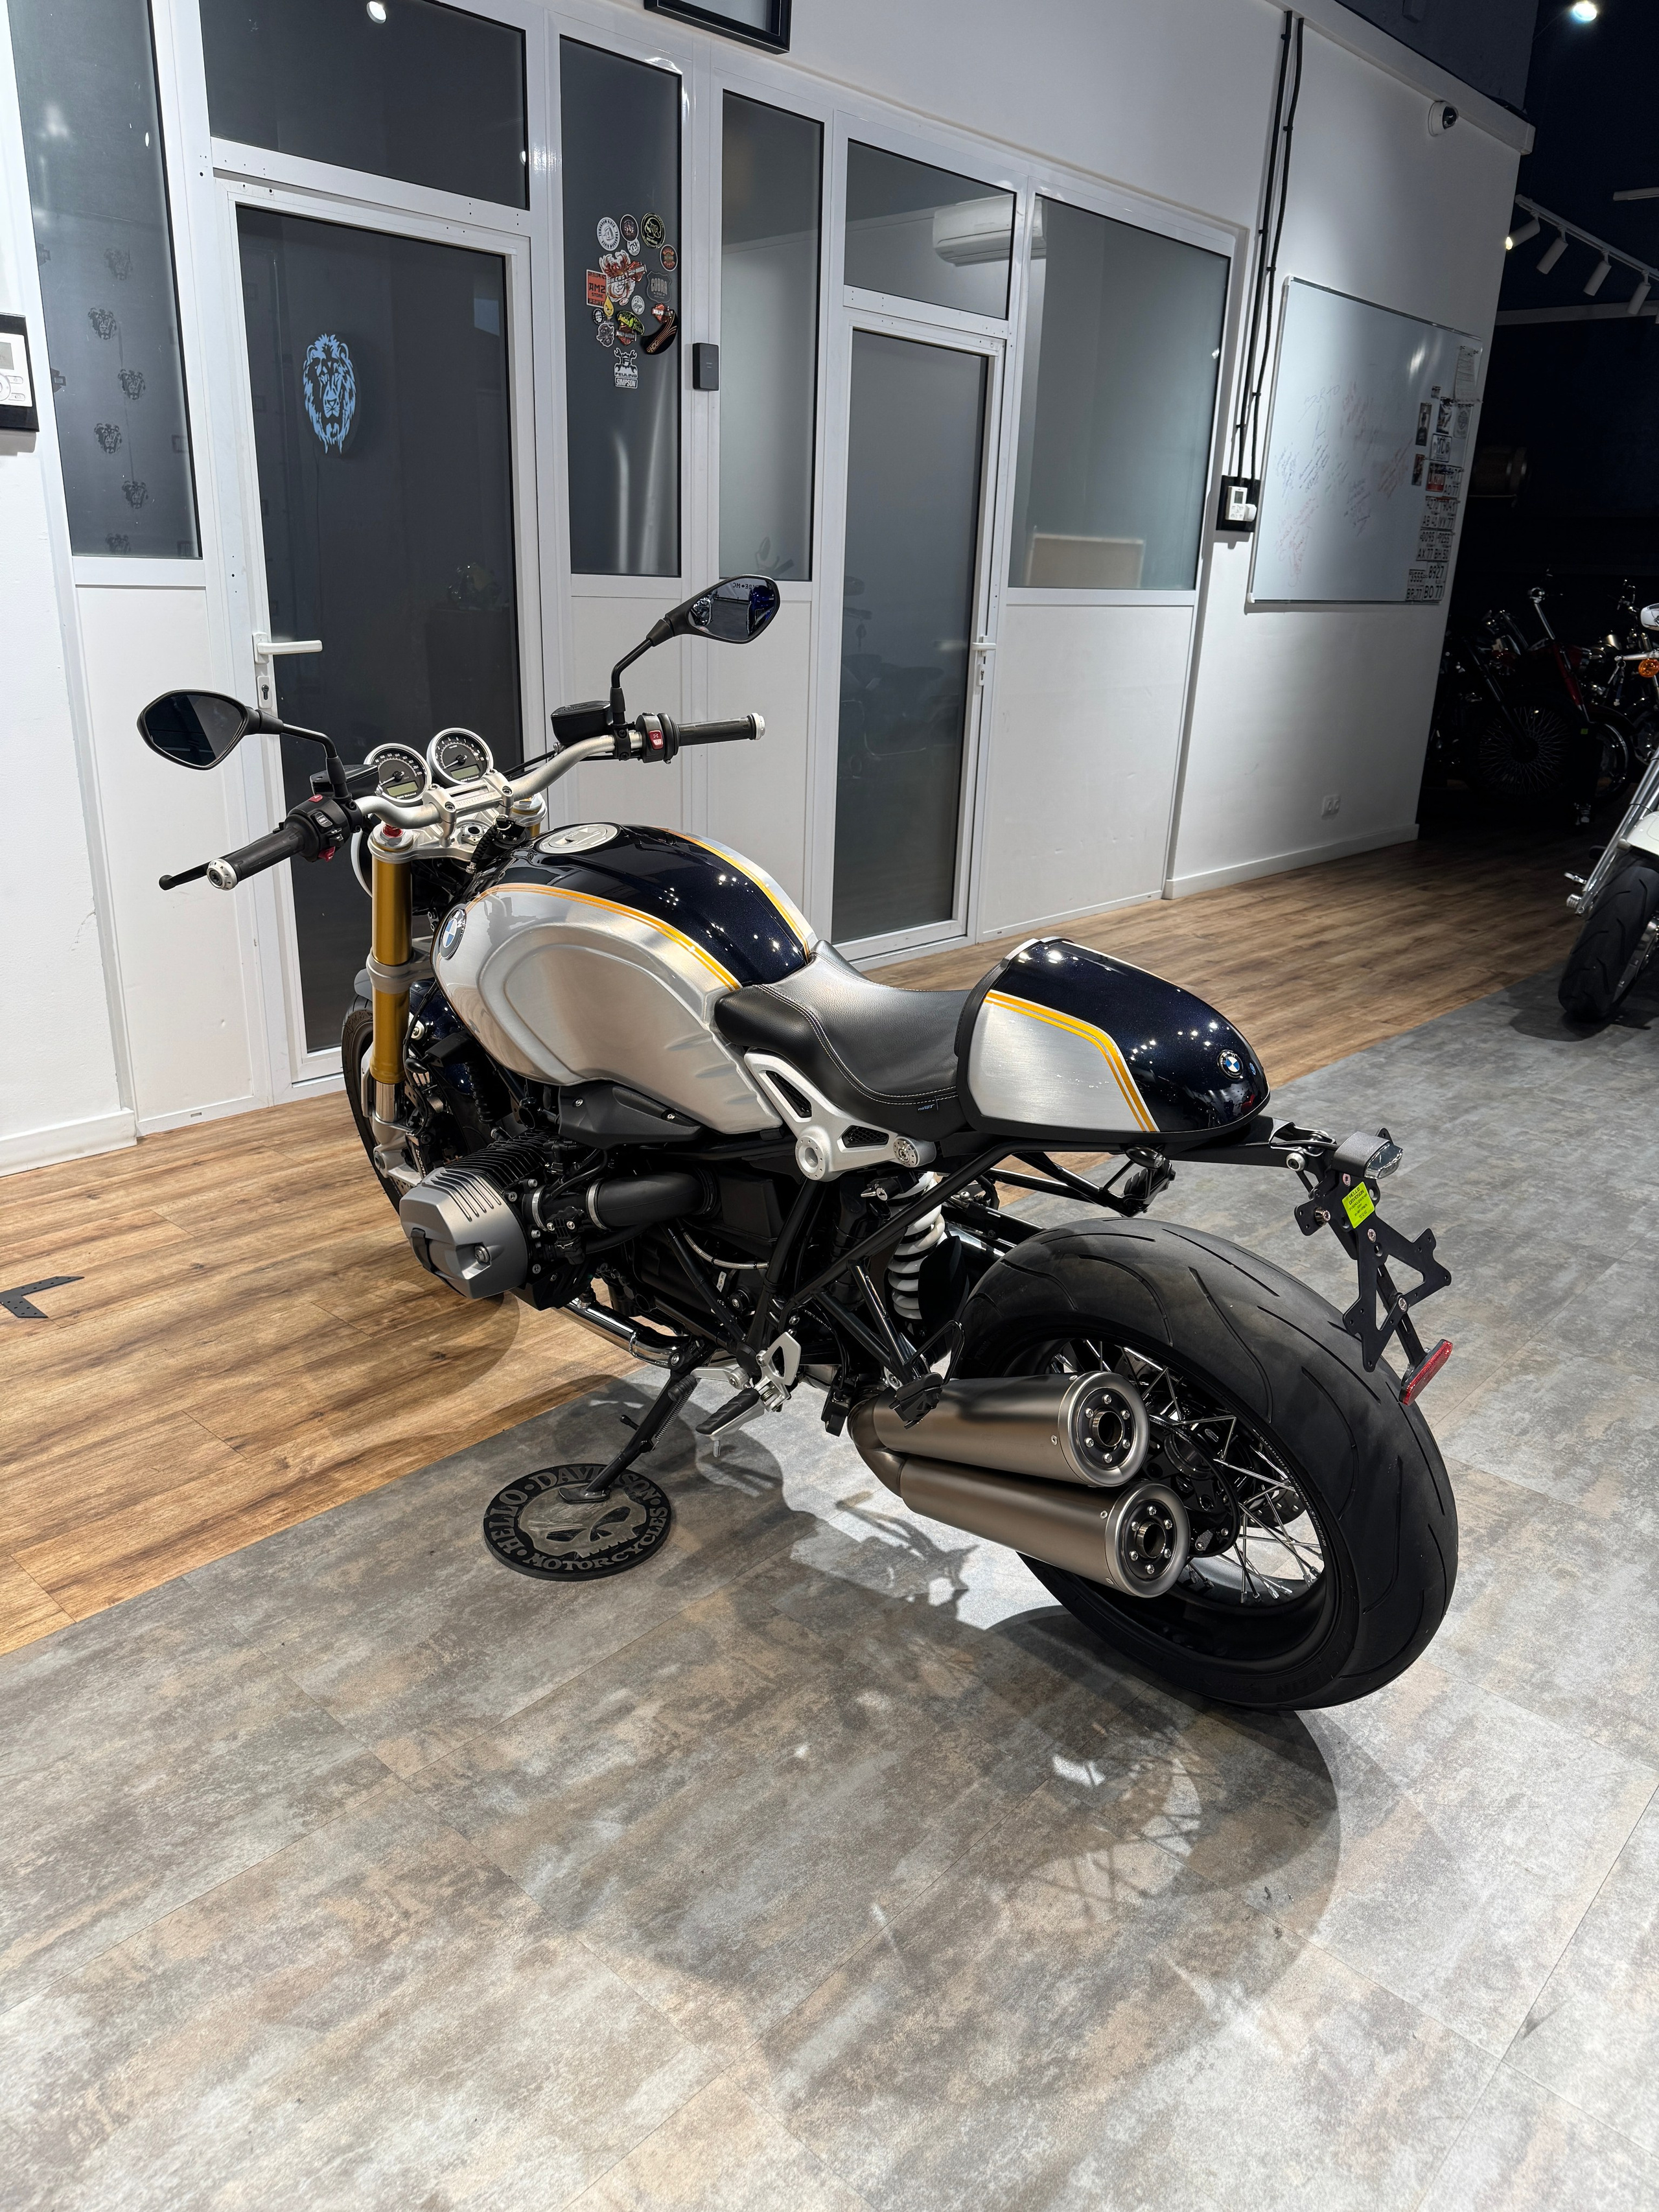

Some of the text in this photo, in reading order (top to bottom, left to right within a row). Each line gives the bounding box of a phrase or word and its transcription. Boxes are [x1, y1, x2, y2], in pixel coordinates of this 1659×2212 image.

[651, 277, 668, 296] COBRA
[616, 378, 636, 387] SIMPSON
[1428, 565, 1444, 579] 8927
[1435, 585, 1443, 599] 77
[528, 1465, 662, 1502] DAVISON
[489, 1489, 528, 1555] HELLO
[522, 1506, 668, 1571] MOTORCYCLES
